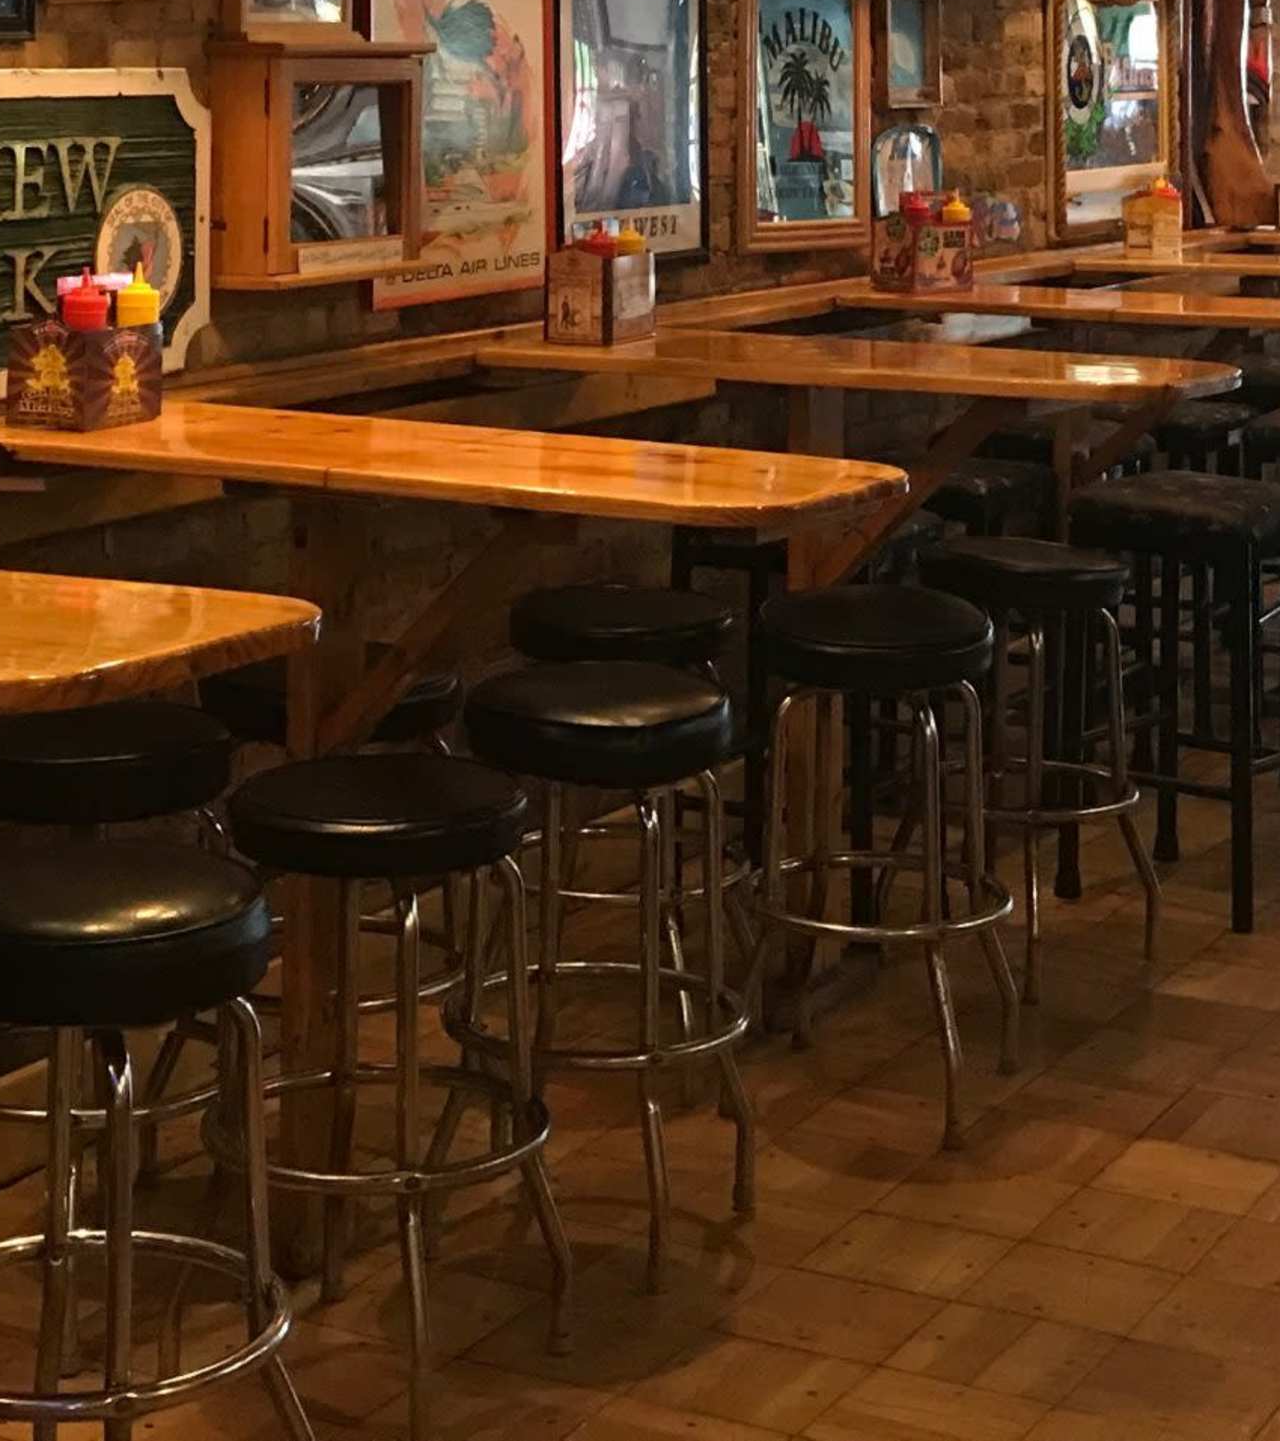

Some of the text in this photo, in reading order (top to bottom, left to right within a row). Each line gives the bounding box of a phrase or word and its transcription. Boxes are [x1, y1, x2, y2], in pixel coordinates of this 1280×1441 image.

[764, 7, 846, 73] MALIBU
[401, 251, 542, 285] DELTA AIR LINES
